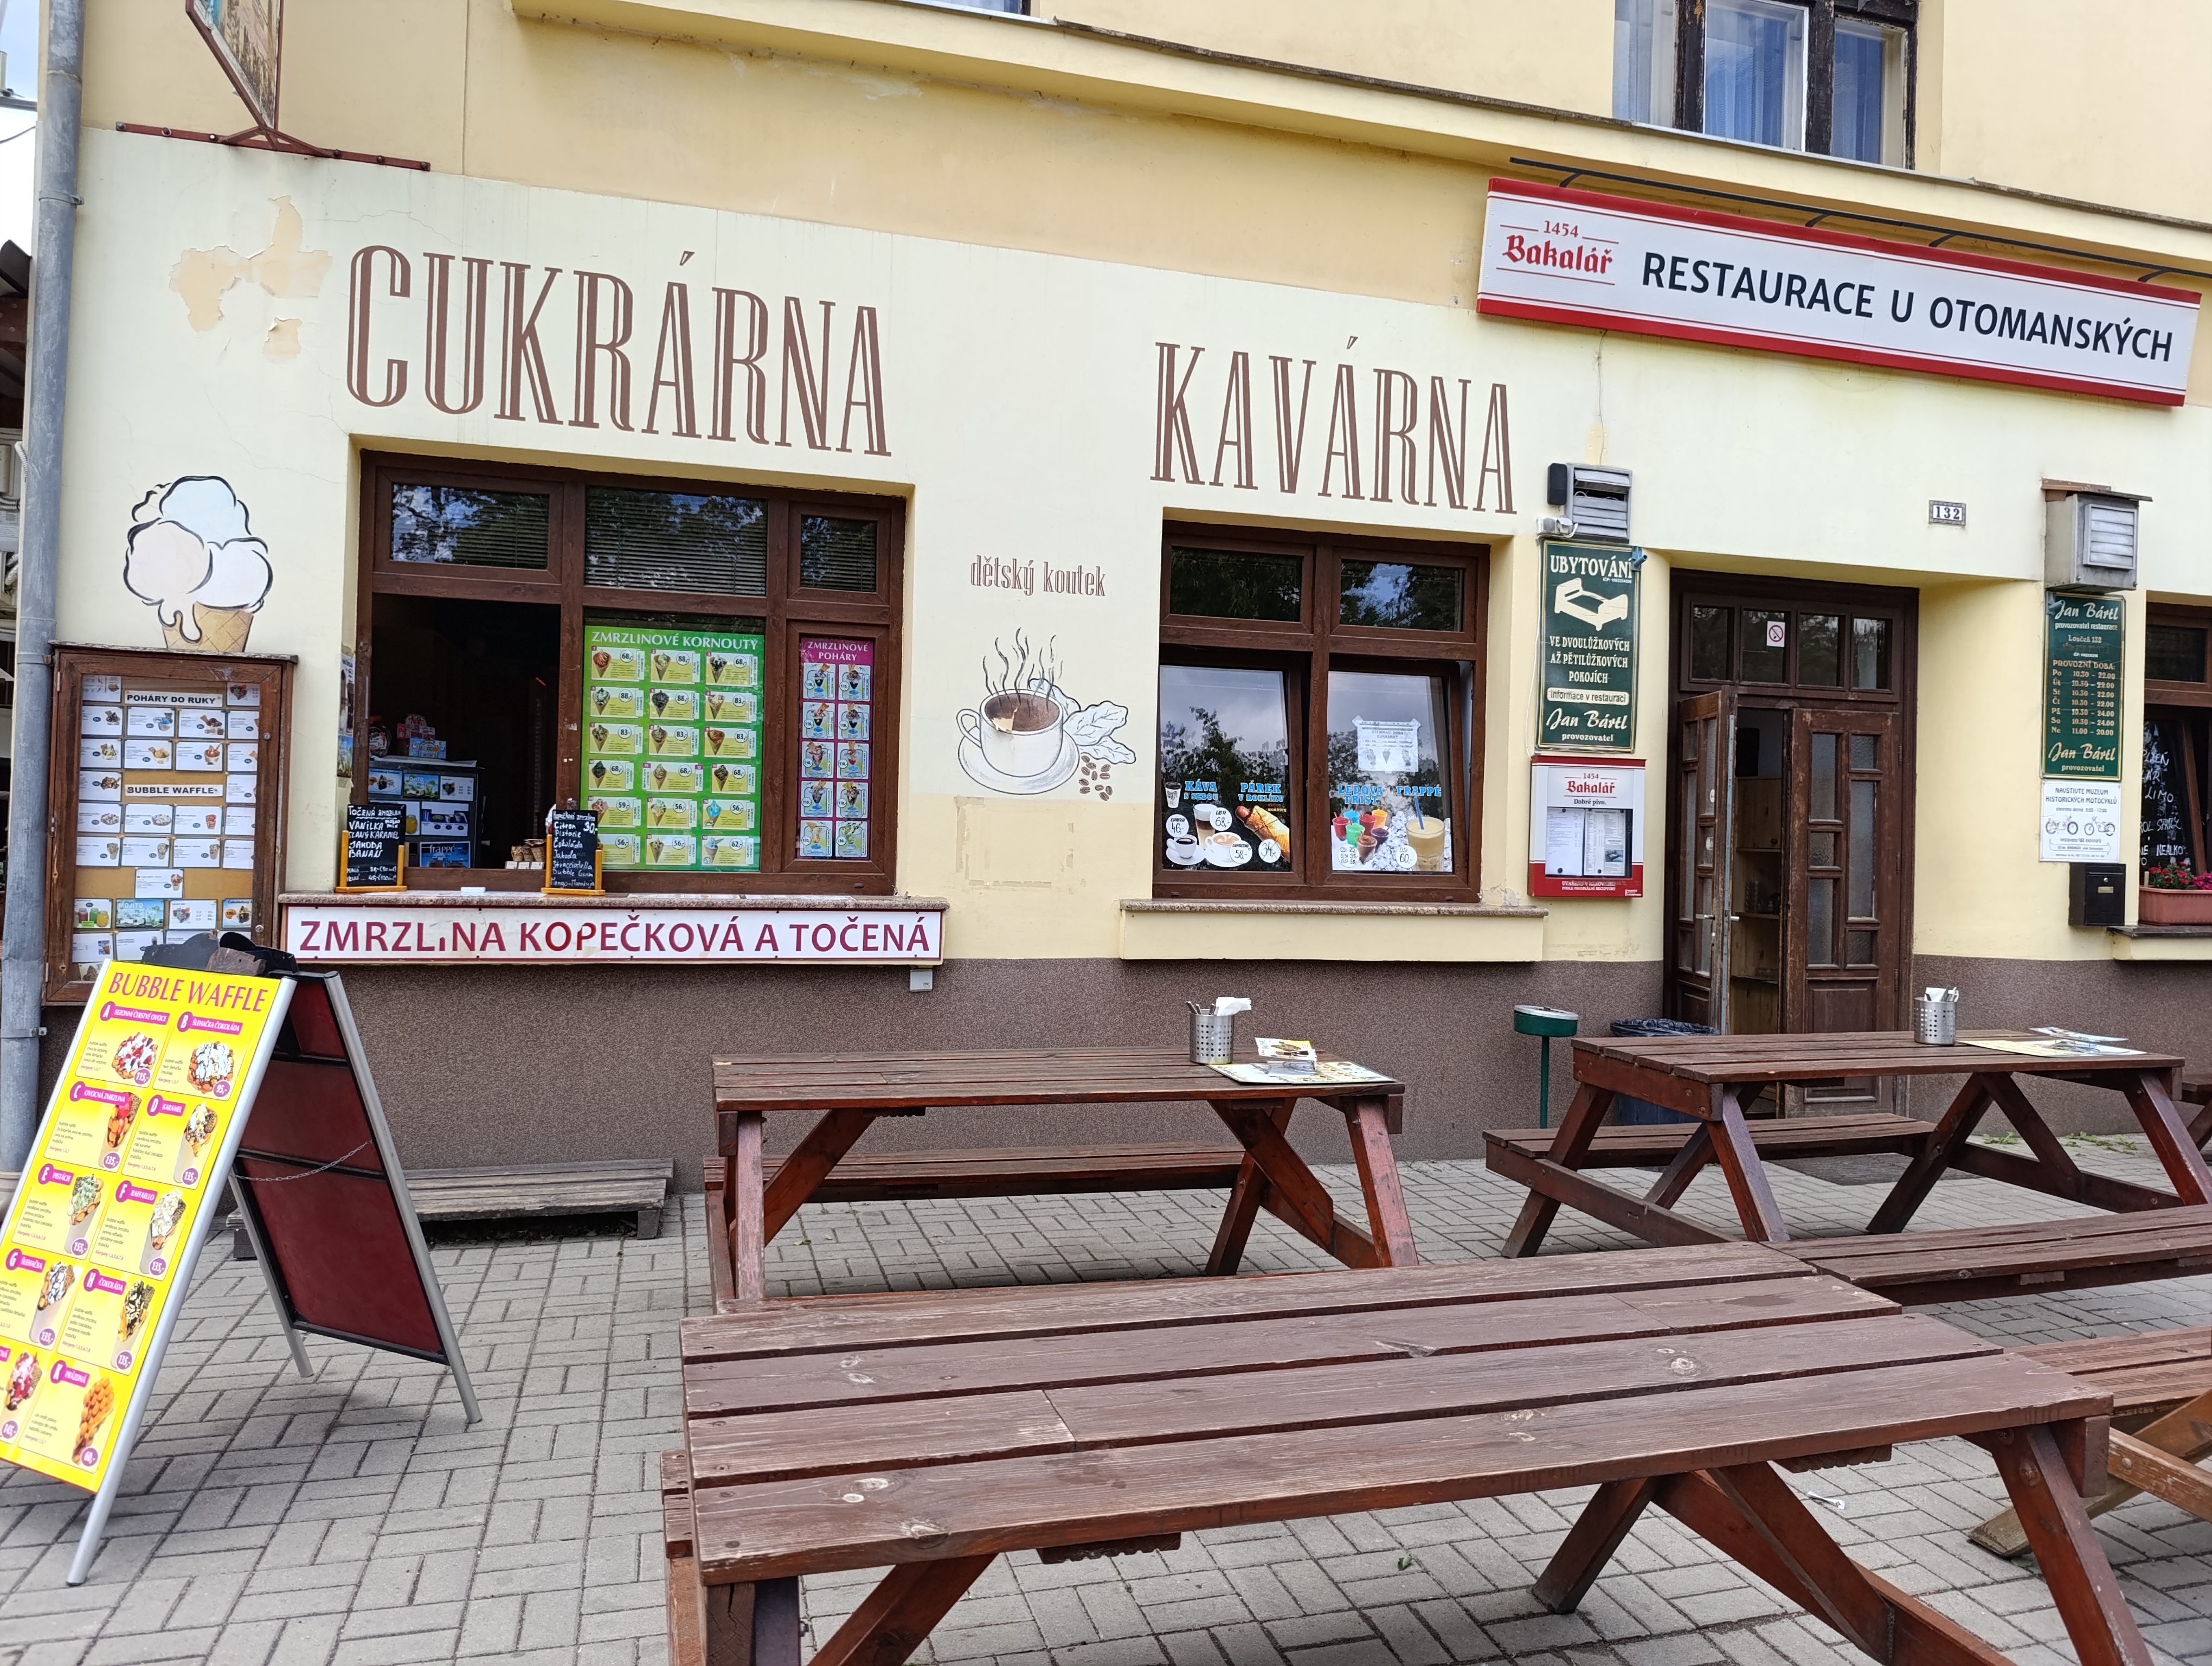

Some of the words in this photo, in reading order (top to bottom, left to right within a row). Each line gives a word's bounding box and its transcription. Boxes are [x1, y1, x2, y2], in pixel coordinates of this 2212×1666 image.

[1543, 220, 1579, 238] 1454
[1502, 234, 1613, 274] Bakalář
[1642, 252, 1875, 319] RESTAURACE
[1891, 289, 1913, 323] U
[1929, 297, 2173, 362] OTOMANSKÝCH
[347, 245, 891, 457] CUKRÁRNA
[1150, 336, 1517, 515] KAVÁRNA
[1936, 506, 1960, 520] 132
[1550, 555, 1632, 579] UBYTOVÁNÍ
[971, 555, 1034, 596] dětský
[1043, 561, 1106, 597] koutek
[2055, 603, 2079, 619] Jan
[2083, 602, 2119, 620] Bártl
[591, 631, 679, 646] ZMRZLINOVÉ
[683, 636, 758, 650] KORNOUTY
[808, 641, 869, 652] ZMRZLINOVÉ
[1549, 636, 1560, 647] VE
[1562, 636, 1630, 651] DVOULŮŽKOVÝCH
[621, 652, 633, 661] 68,-
[819, 651, 858, 662] POHÁRY
[1551, 653, 1561, 664] AŽ
[1563, 651, 1628, 668] PĚTILŮŽKOVÝCH
[2053, 659, 2091, 668] PROVOZNÍ
[2093, 662, 2115, 670] DOBA:
[1568, 670, 1608, 683] POKOJÍCH
[2053, 677, 2061, 685] Út
[127, 694, 168, 703] POHÁRY
[171, 695, 184, 703] DO
[188, 696, 216, 704] RUKY
[1551, 689, 1584, 701] informace
[1591, 693, 1626, 703] restauraci
[2052, 696, 2060, 704] Čt
[1546, 708, 1578, 730] Jan
[1584, 710, 1628, 730] Bártl
[1561, 733, 1613, 742] provozovatel
[2048, 742, 2076, 762] Jan
[2080, 743, 2115, 761] Bártl
[2061, 764, 2105, 772] provozovatel
[128, 786, 169, 794] BUBBLE
[172, 786, 215, 794] WAFFLE
[1185, 779, 1218, 791] KÁVA
[1240, 780, 1281, 794] PÁREK
[1396, 784, 1442, 796] FRAPPÉ
[1566, 780, 1615, 794] Bakalář
[1246, 792, 1284, 802] ROHLÍKU
[2145, 786, 2174, 802] LIMO
[348, 806, 376, 817] TOČENÁ
[1172, 822, 1184, 834] 46,-
[1215, 817, 1230, 828] 68,-
[555, 829, 581, 838] Pistacie
[349, 841, 382, 850] JAHODA
[429, 844, 456, 853] frappé
[554, 837, 583, 849] Čokoláda
[553, 849, 577, 859] Jahoda
[1234, 849, 1247, 860] 58,-
[2156, 844, 2183, 856] NEALKO
[1399, 853, 1412, 864] 60,-
[520, 914, 744, 952] KOPEČKOVÁ
[754, 924, 779, 952] A
[790, 916, 929, 953] TOČENÁ
[108, 972, 185, 1002] BUBBLE
[188, 981, 268, 1012] WAFFLE
[102, 1004, 111, 1018] A
[181, 1015, 189, 1029] B
[136, 1072, 150, 1083] 115,-
[74, 1085, 81, 1098] C
[216, 1085, 227, 1094] 95,-
[151, 1098, 159, 1112] D
[162, 1103, 183, 1113] KARAMEL
[105, 1155, 118, 1166] 135,-
[41, 1167, 50, 1181] E
[52, 1171, 71, 1182] PISTÁCIE
[184, 1172, 197, 1183] 135,-
[119, 1184, 127, 1199] F
[130, 1189, 155, 1201] RAFFAELLO
[73, 1243, 86, 1254] 155,-
[9, 1252, 18, 1267] G
[151, 1261, 164, 1273] 135,-
[87, 1272, 96, 1288] H
[41, 1332, 54, 1344] 135,-
[118, 1356, 131, 1367] 135,-
[53, 1363, 63, 1380] K
[3, 1424, 16, 1437] 145,-
[83, 1451, 95, 1463] 60,-
